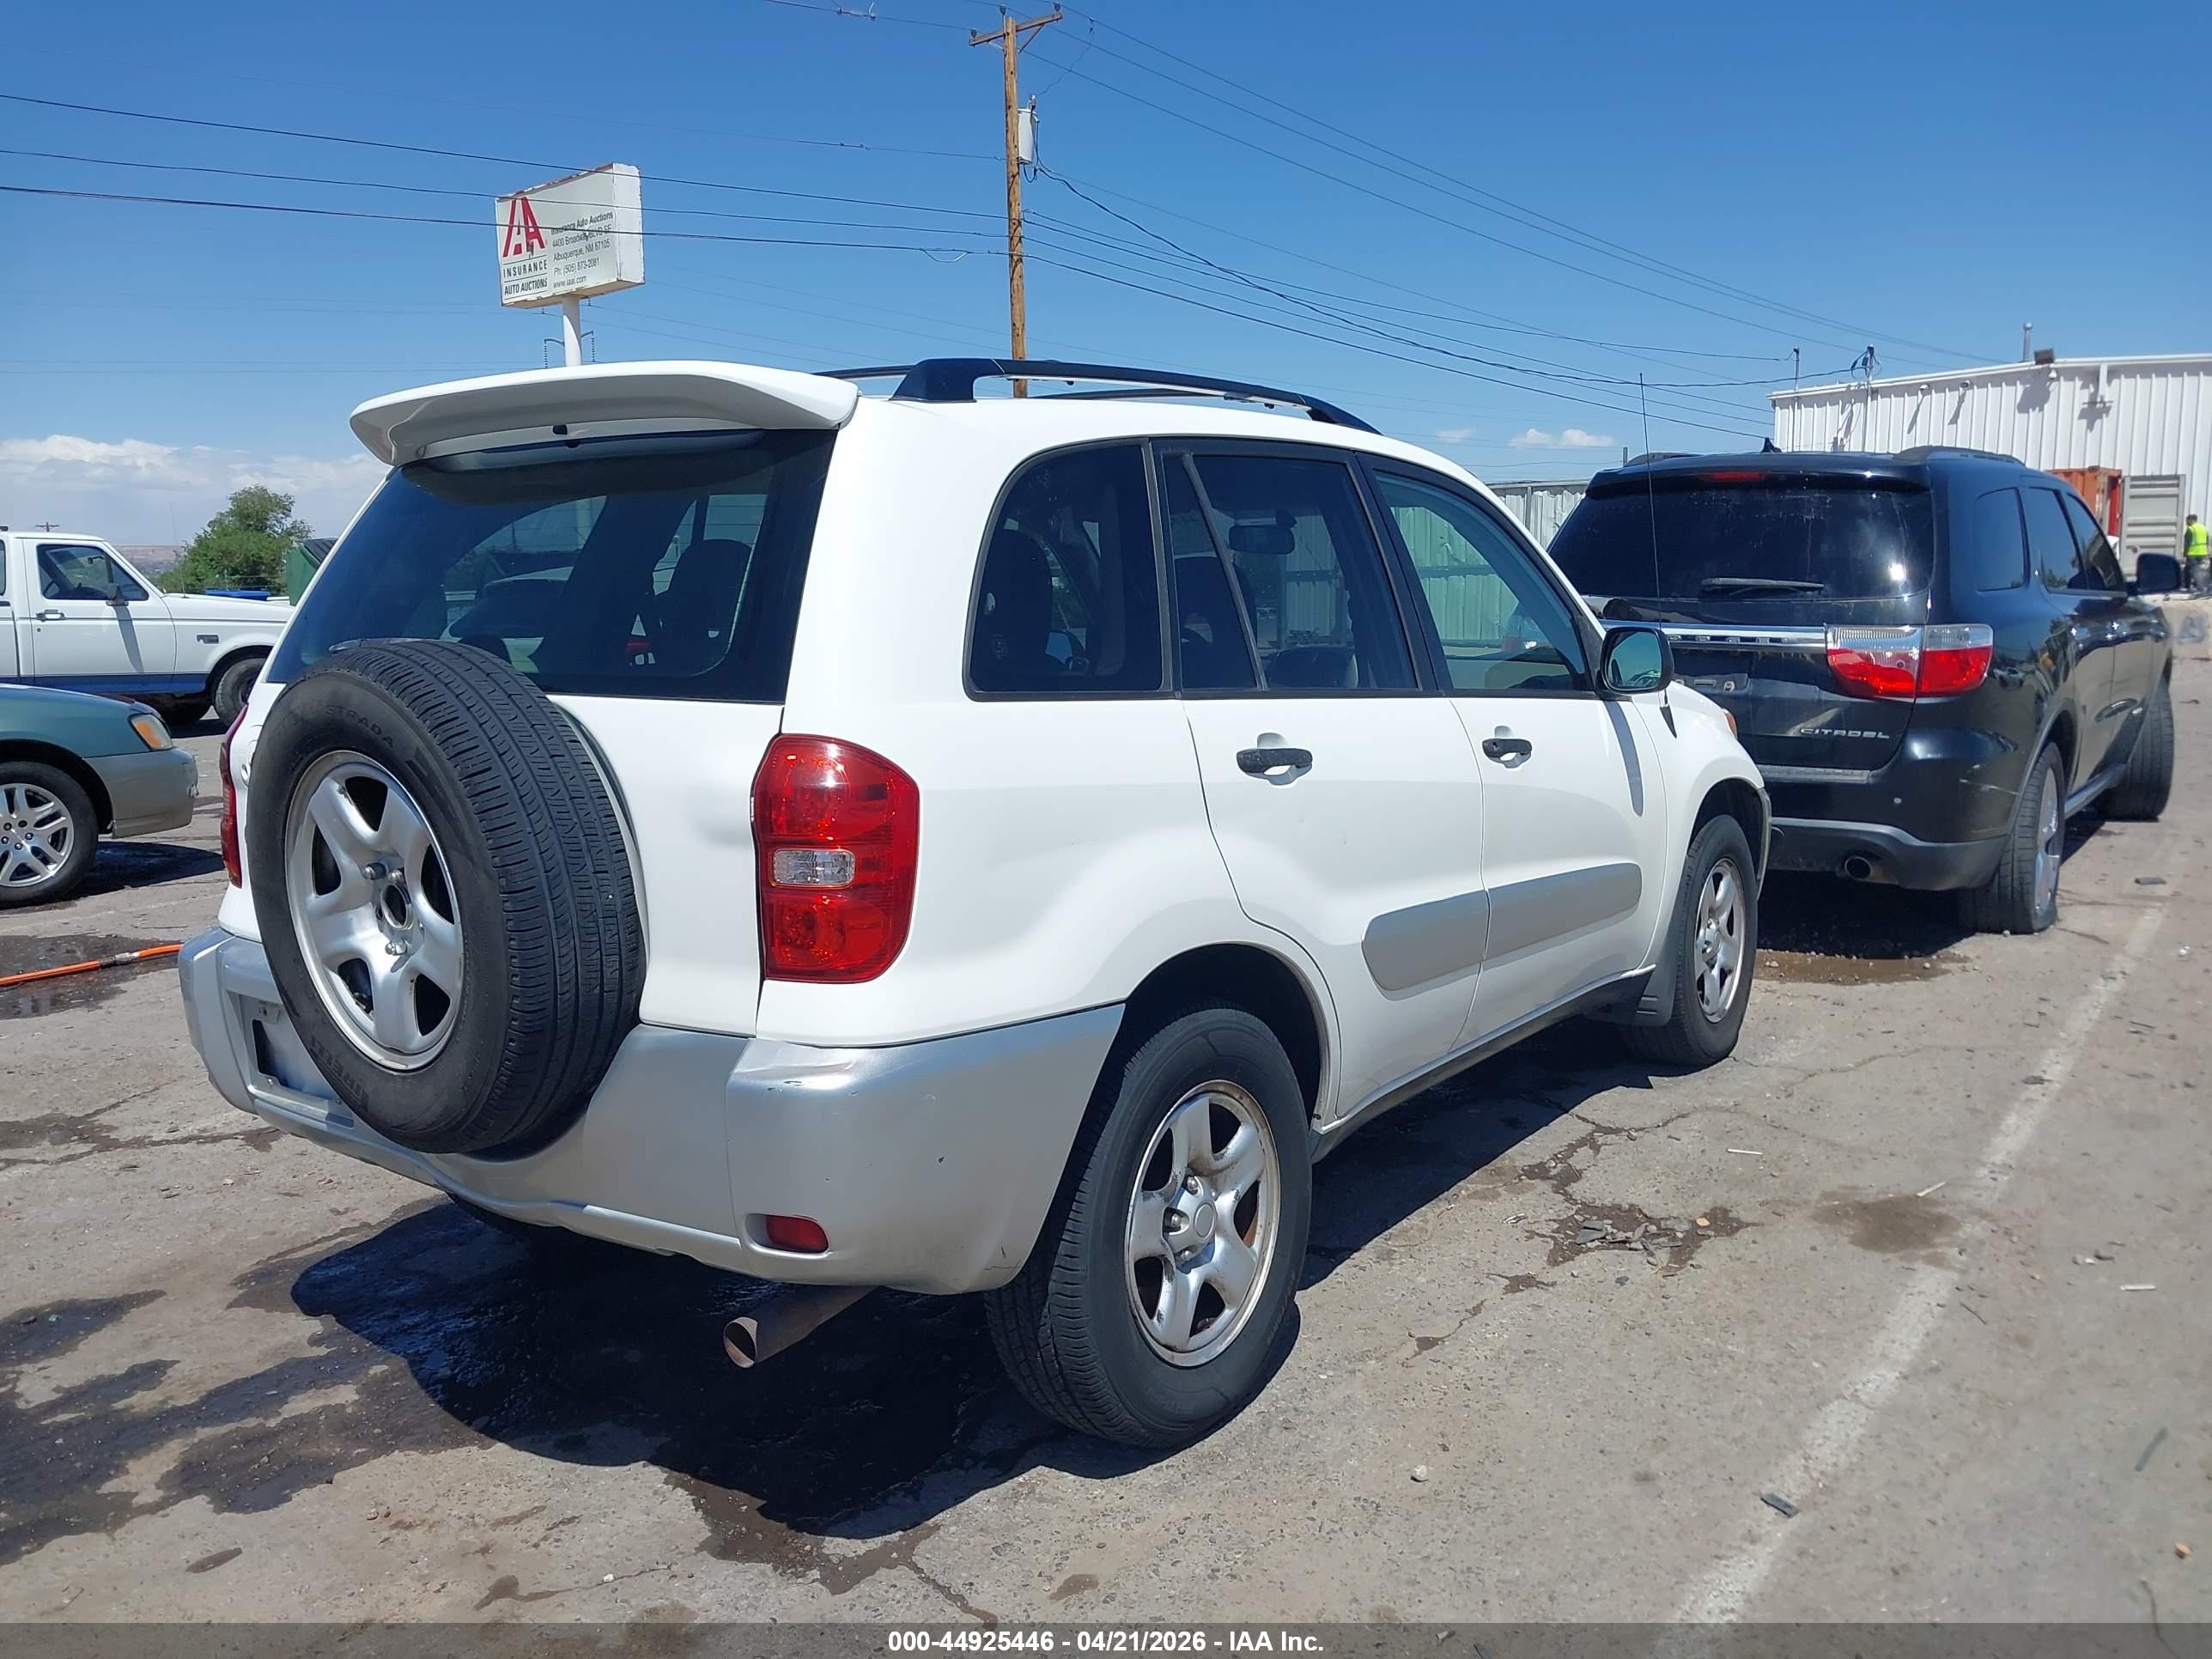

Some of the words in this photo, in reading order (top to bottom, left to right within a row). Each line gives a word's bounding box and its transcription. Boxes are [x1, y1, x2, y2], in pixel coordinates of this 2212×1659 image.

[576, 217, 588, 229] Auto
[589, 211, 613, 226] Auctions
[585, 242, 594, 254] NM
[594, 238, 611, 252] 87105
[503, 259, 548, 278] INSURANCE
[504, 283, 520, 296] AUTO
[520, 277, 548, 293] AUCTIONS
[1800, 728, 1890, 739] CITADEL
